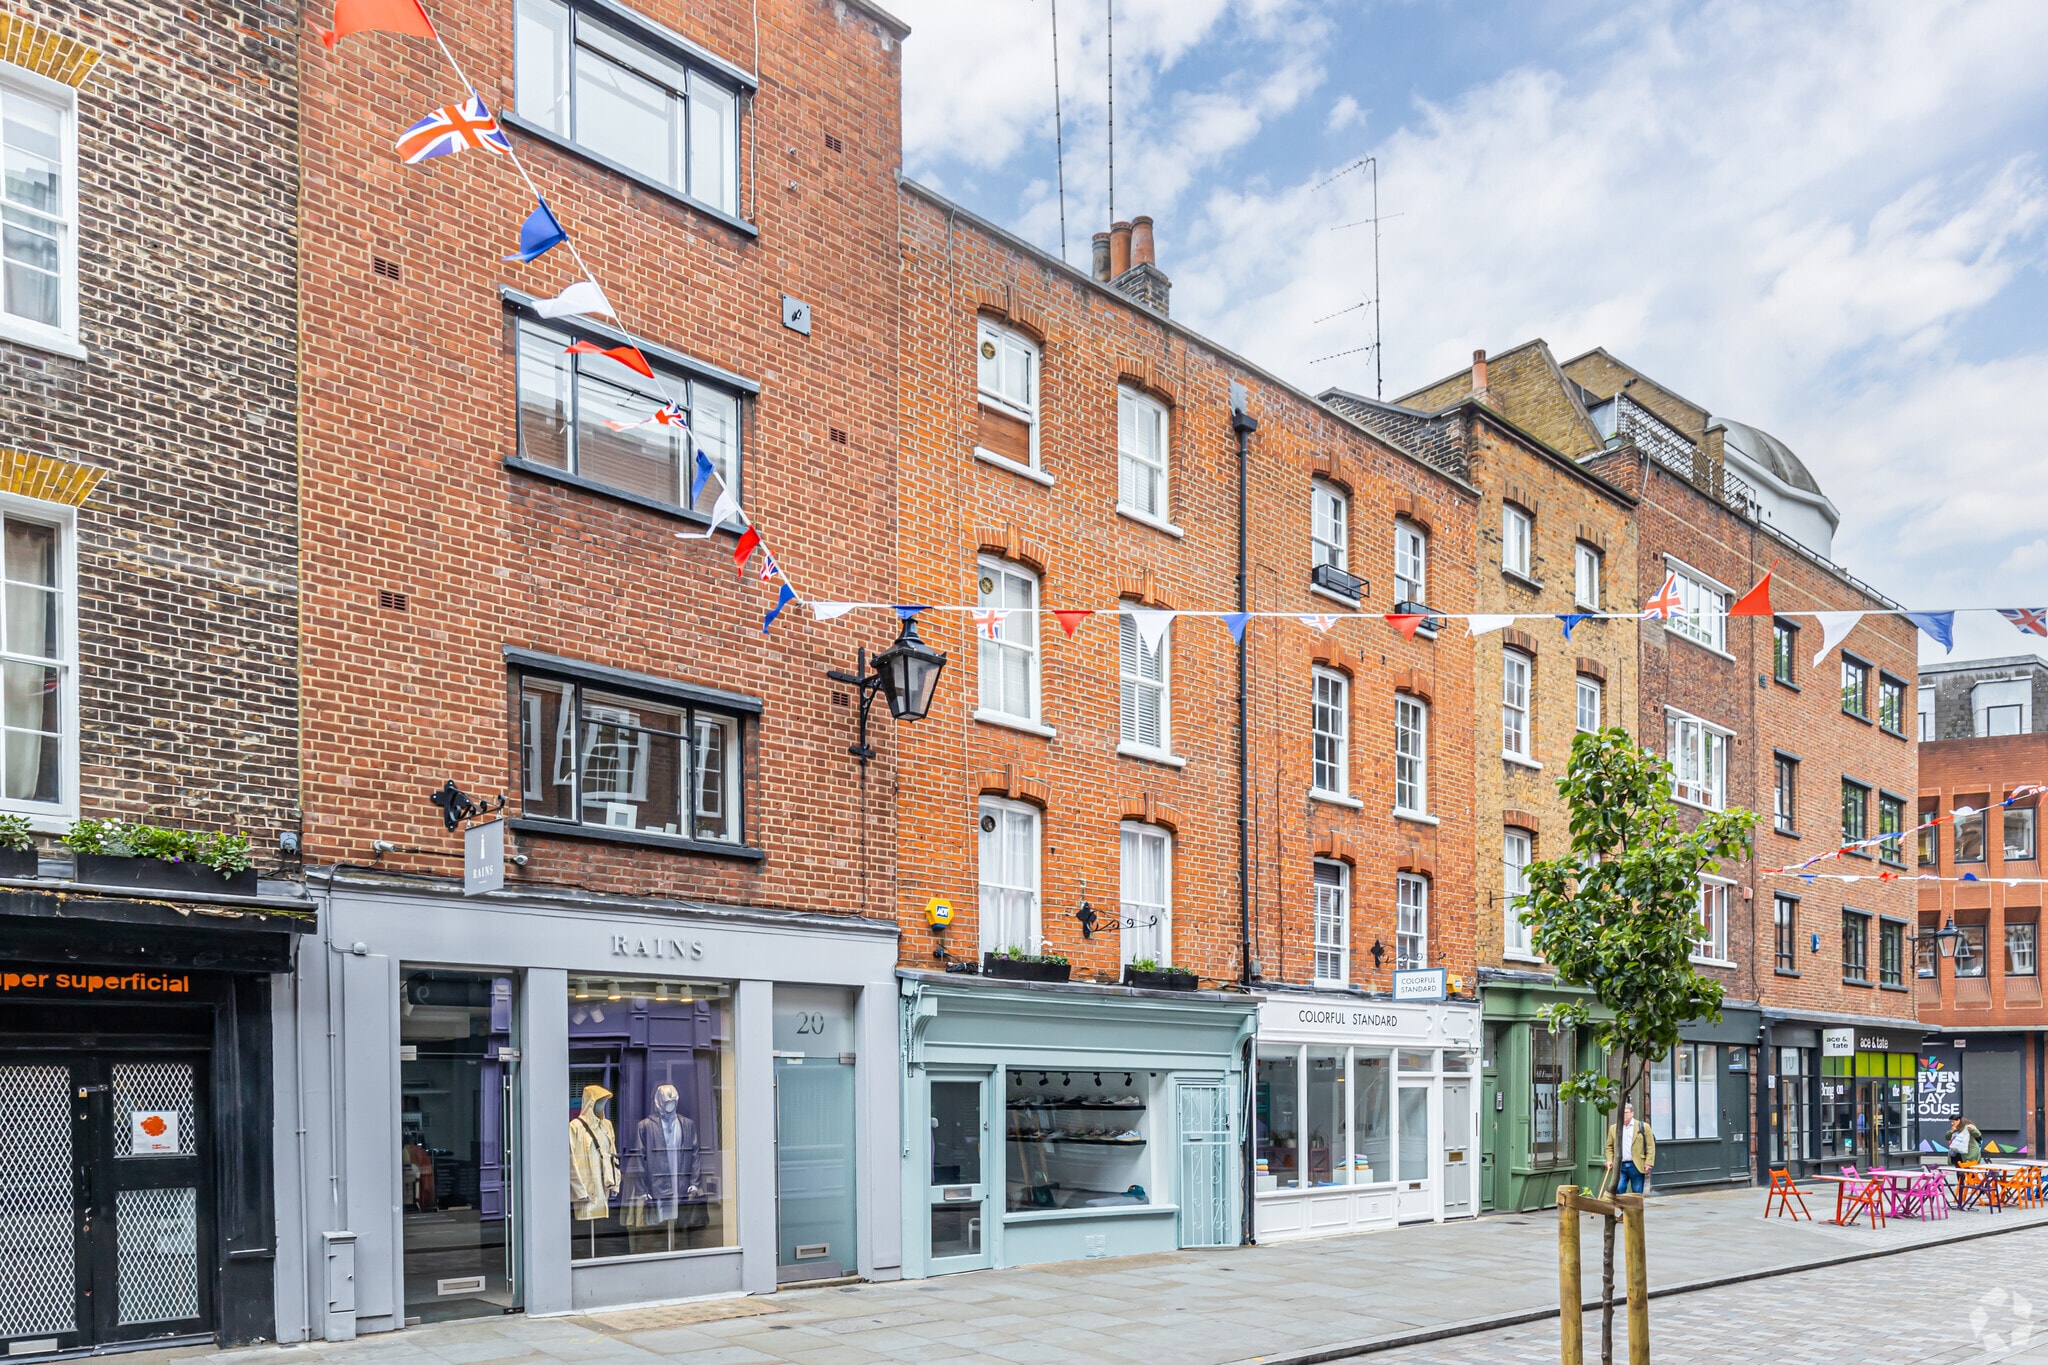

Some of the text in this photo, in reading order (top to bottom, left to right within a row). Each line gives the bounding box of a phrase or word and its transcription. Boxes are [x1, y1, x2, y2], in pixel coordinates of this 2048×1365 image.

[472, 864, 495, 880] RAINS
[611, 933, 704, 961] RAINS
[0, 972, 190, 993] per superficial
[1401, 976, 1437, 986] COLORFUL
[1400, 985, 1437, 994] STANDARD
[796, 1011, 825, 1035] 20
[1298, 1009, 1398, 1027] COLORFUL STANDARD
[1860, 1037, 1871, 1048] ace
[1876, 1036, 1889, 1049] tate
[1917, 1071, 1960, 1083] EVEN
[1918, 1081, 1957, 1094] IALS
